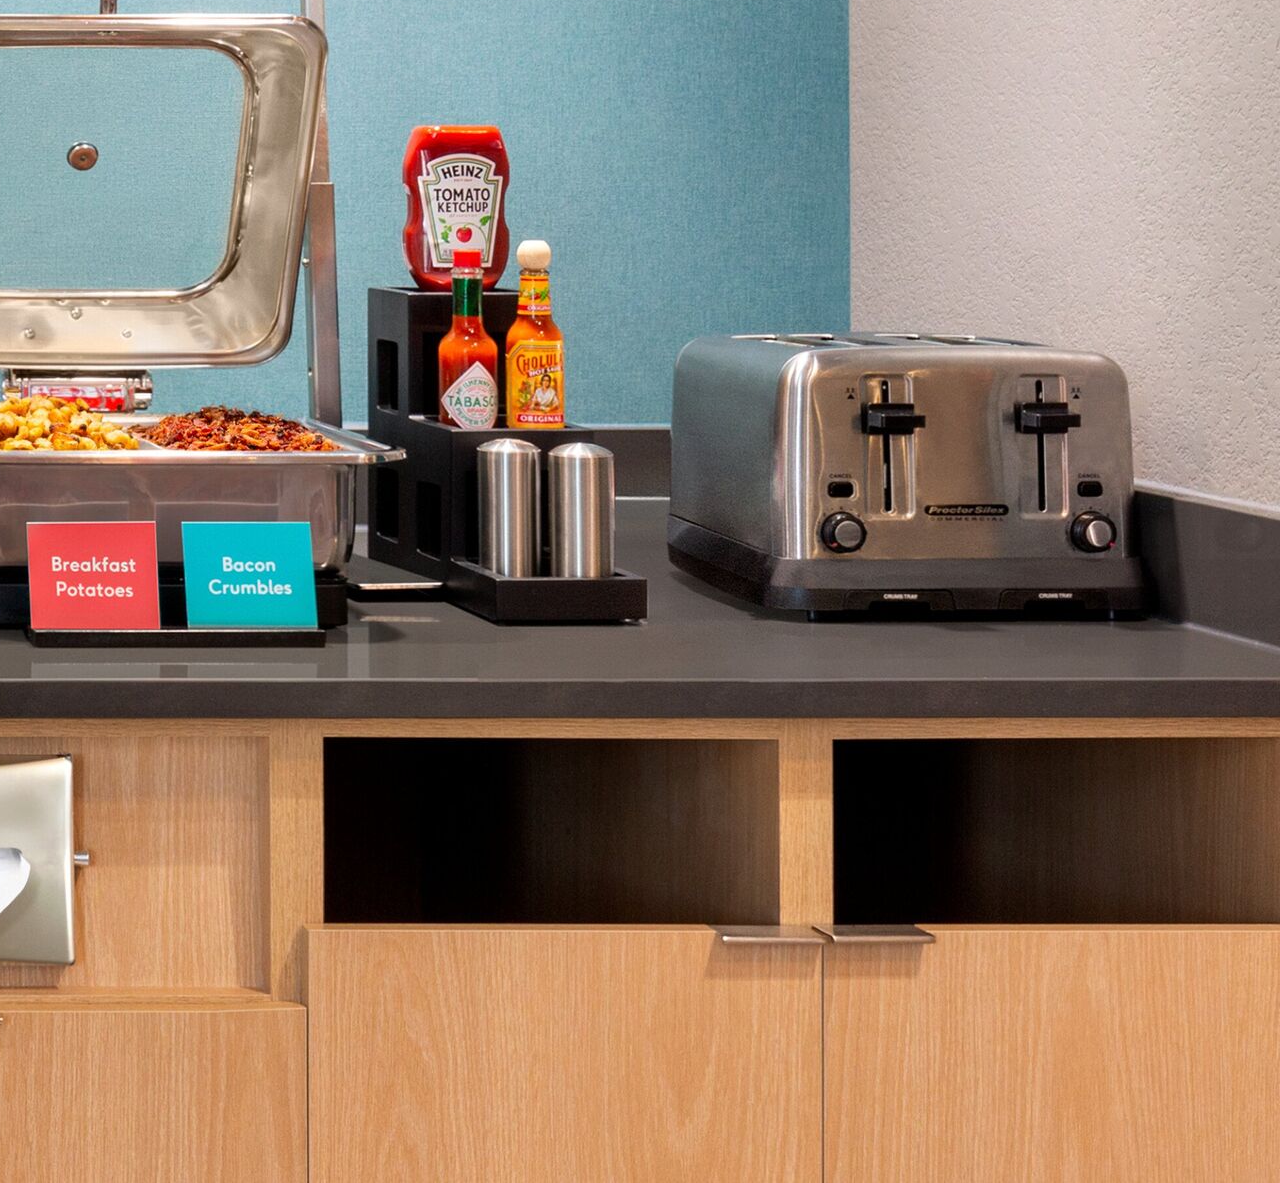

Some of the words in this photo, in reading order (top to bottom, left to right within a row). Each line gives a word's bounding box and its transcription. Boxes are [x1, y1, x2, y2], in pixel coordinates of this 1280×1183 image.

[441, 165, 483, 179] HEINZ
[434, 188, 490, 201] TOMATO
[438, 202, 488, 213] KETCHUP
[448, 395, 496, 407] TABASC
[51, 556, 136, 573] Breakfast
[222, 556, 276, 572] Bacon
[56, 581, 134, 598] Potatoes
[208, 578, 292, 595] Crumbles
